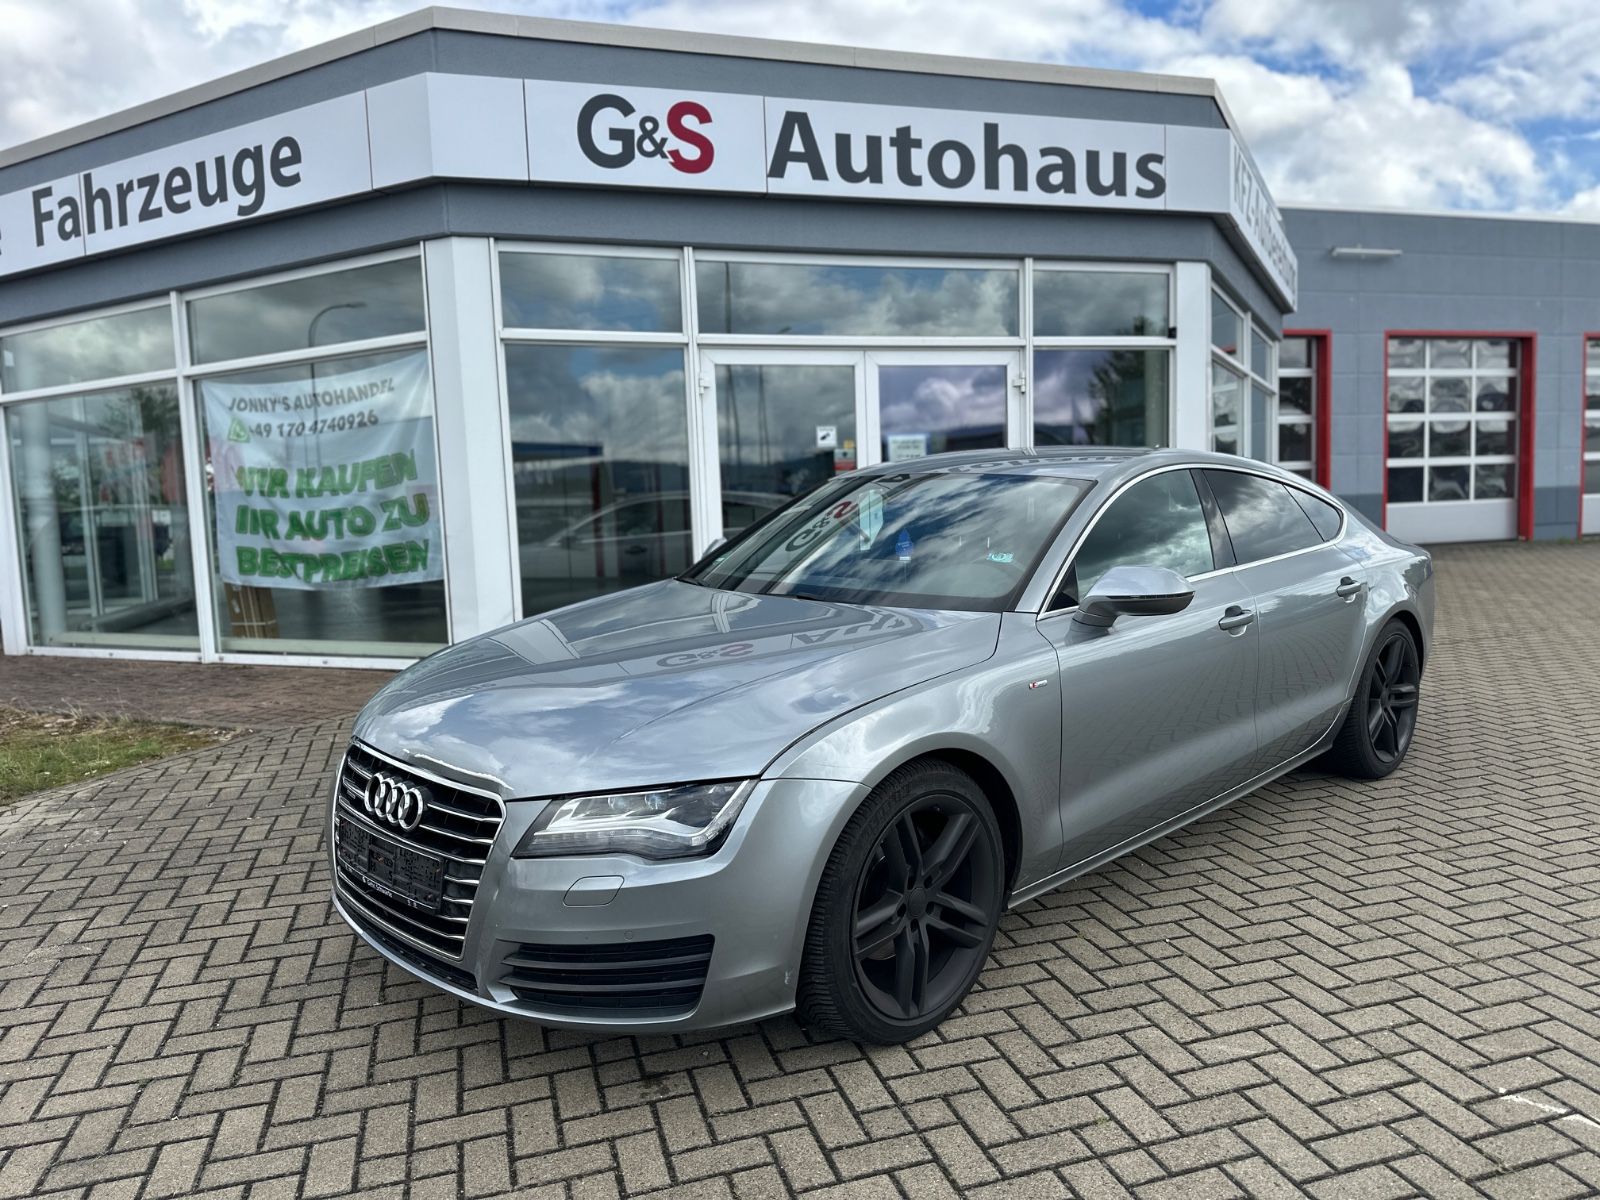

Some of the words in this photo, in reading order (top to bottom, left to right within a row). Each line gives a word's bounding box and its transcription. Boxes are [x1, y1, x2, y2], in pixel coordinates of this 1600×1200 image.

[577, 93, 714, 174] G&S
[767, 110, 1167, 200] Autohaus
[32, 135, 302, 248] Fahrzeuge
[294, 377, 395, 412] AUTOHANDEL
[277, 421, 305, 438] 170
[309, 409, 379, 435] 4740926
[295, 448, 418, 499] KAUFEN
[285, 505, 377, 541] AUTO
[380, 493, 430, 533] ZU
